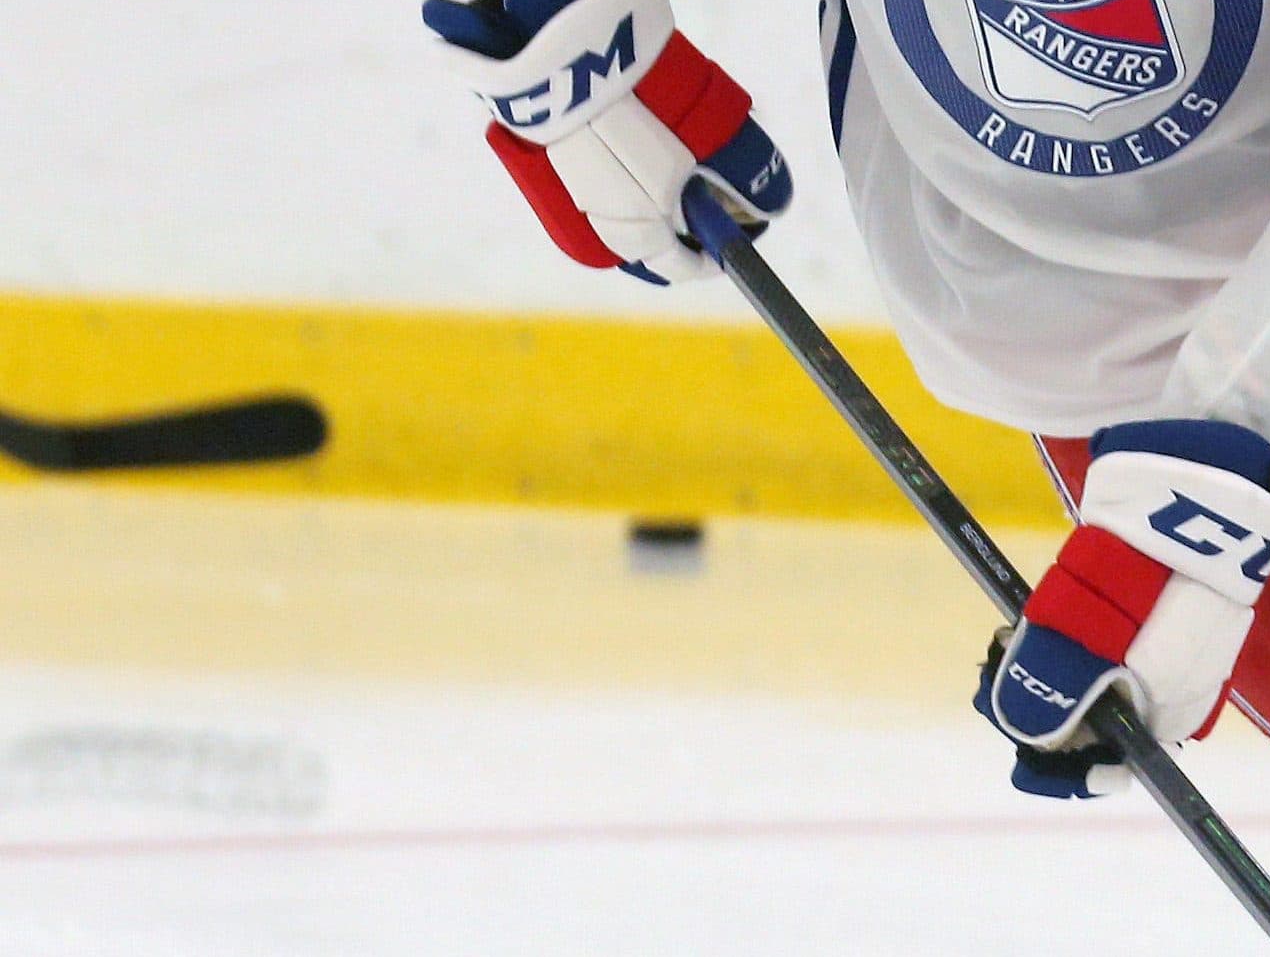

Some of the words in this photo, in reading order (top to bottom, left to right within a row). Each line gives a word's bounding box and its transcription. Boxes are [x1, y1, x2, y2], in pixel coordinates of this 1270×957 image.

[478, 11, 636, 127] CM
[1003, 4, 1162, 86] RANGERS
[977, 91, 1218, 175] RANGERS
[1007, 660, 1077, 710] CCM
